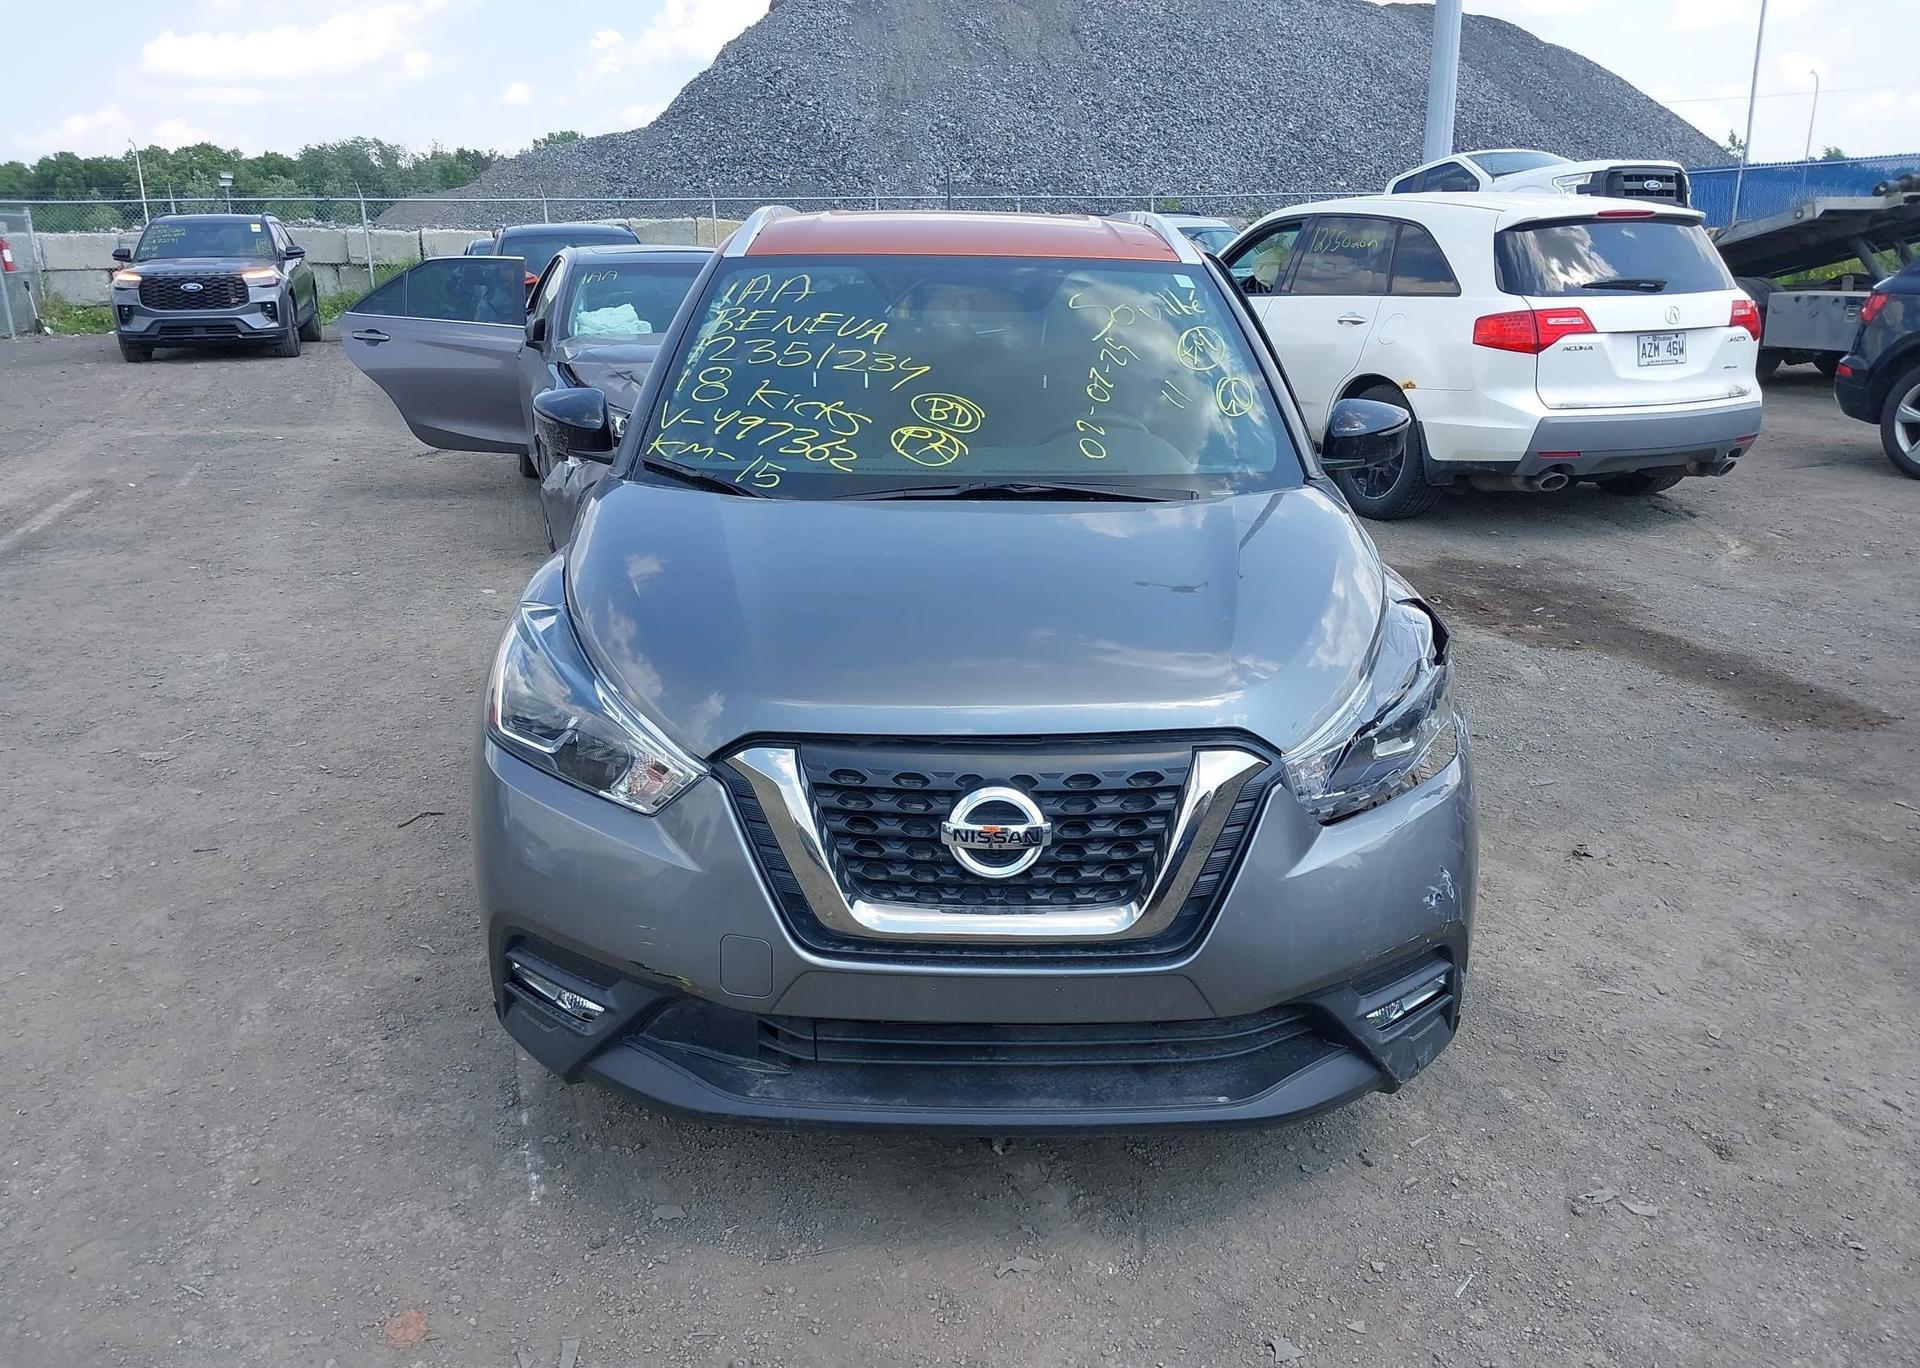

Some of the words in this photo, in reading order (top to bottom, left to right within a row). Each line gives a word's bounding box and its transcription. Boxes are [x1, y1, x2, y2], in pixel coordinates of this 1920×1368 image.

[721, 274, 816, 306] IAA
[1641, 340, 1660, 359] AZM
[1666, 339, 1685, 357] 46W
[676, 367, 733, 402] 18
[953, 827, 1043, 846] NISSAN
